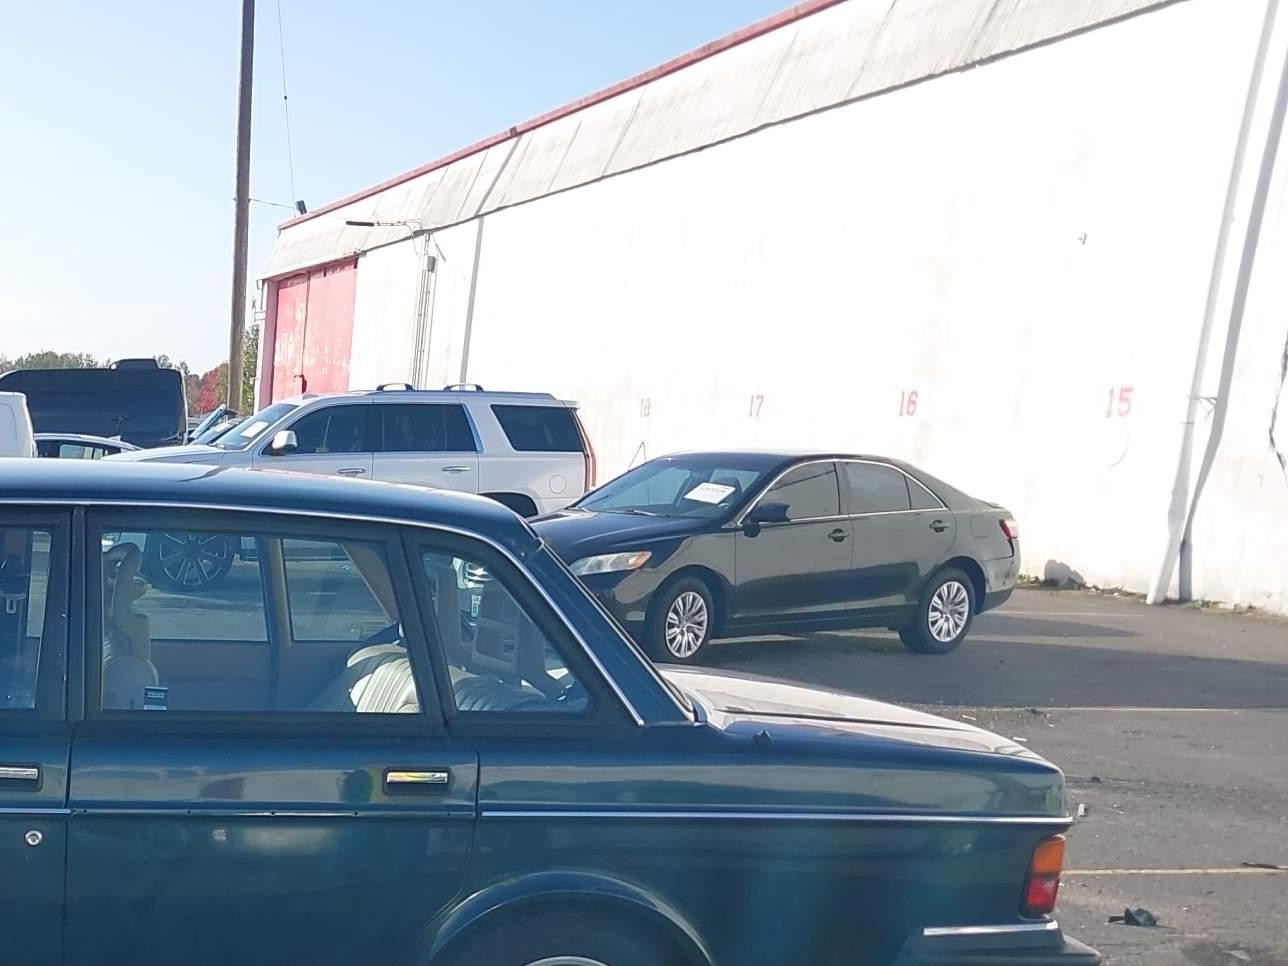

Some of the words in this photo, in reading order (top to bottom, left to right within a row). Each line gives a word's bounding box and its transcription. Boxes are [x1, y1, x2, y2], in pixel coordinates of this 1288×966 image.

[748, 394, 765, 418] 17
[899, 389, 919, 417] 16
[1104, 386, 1134, 419] 15
